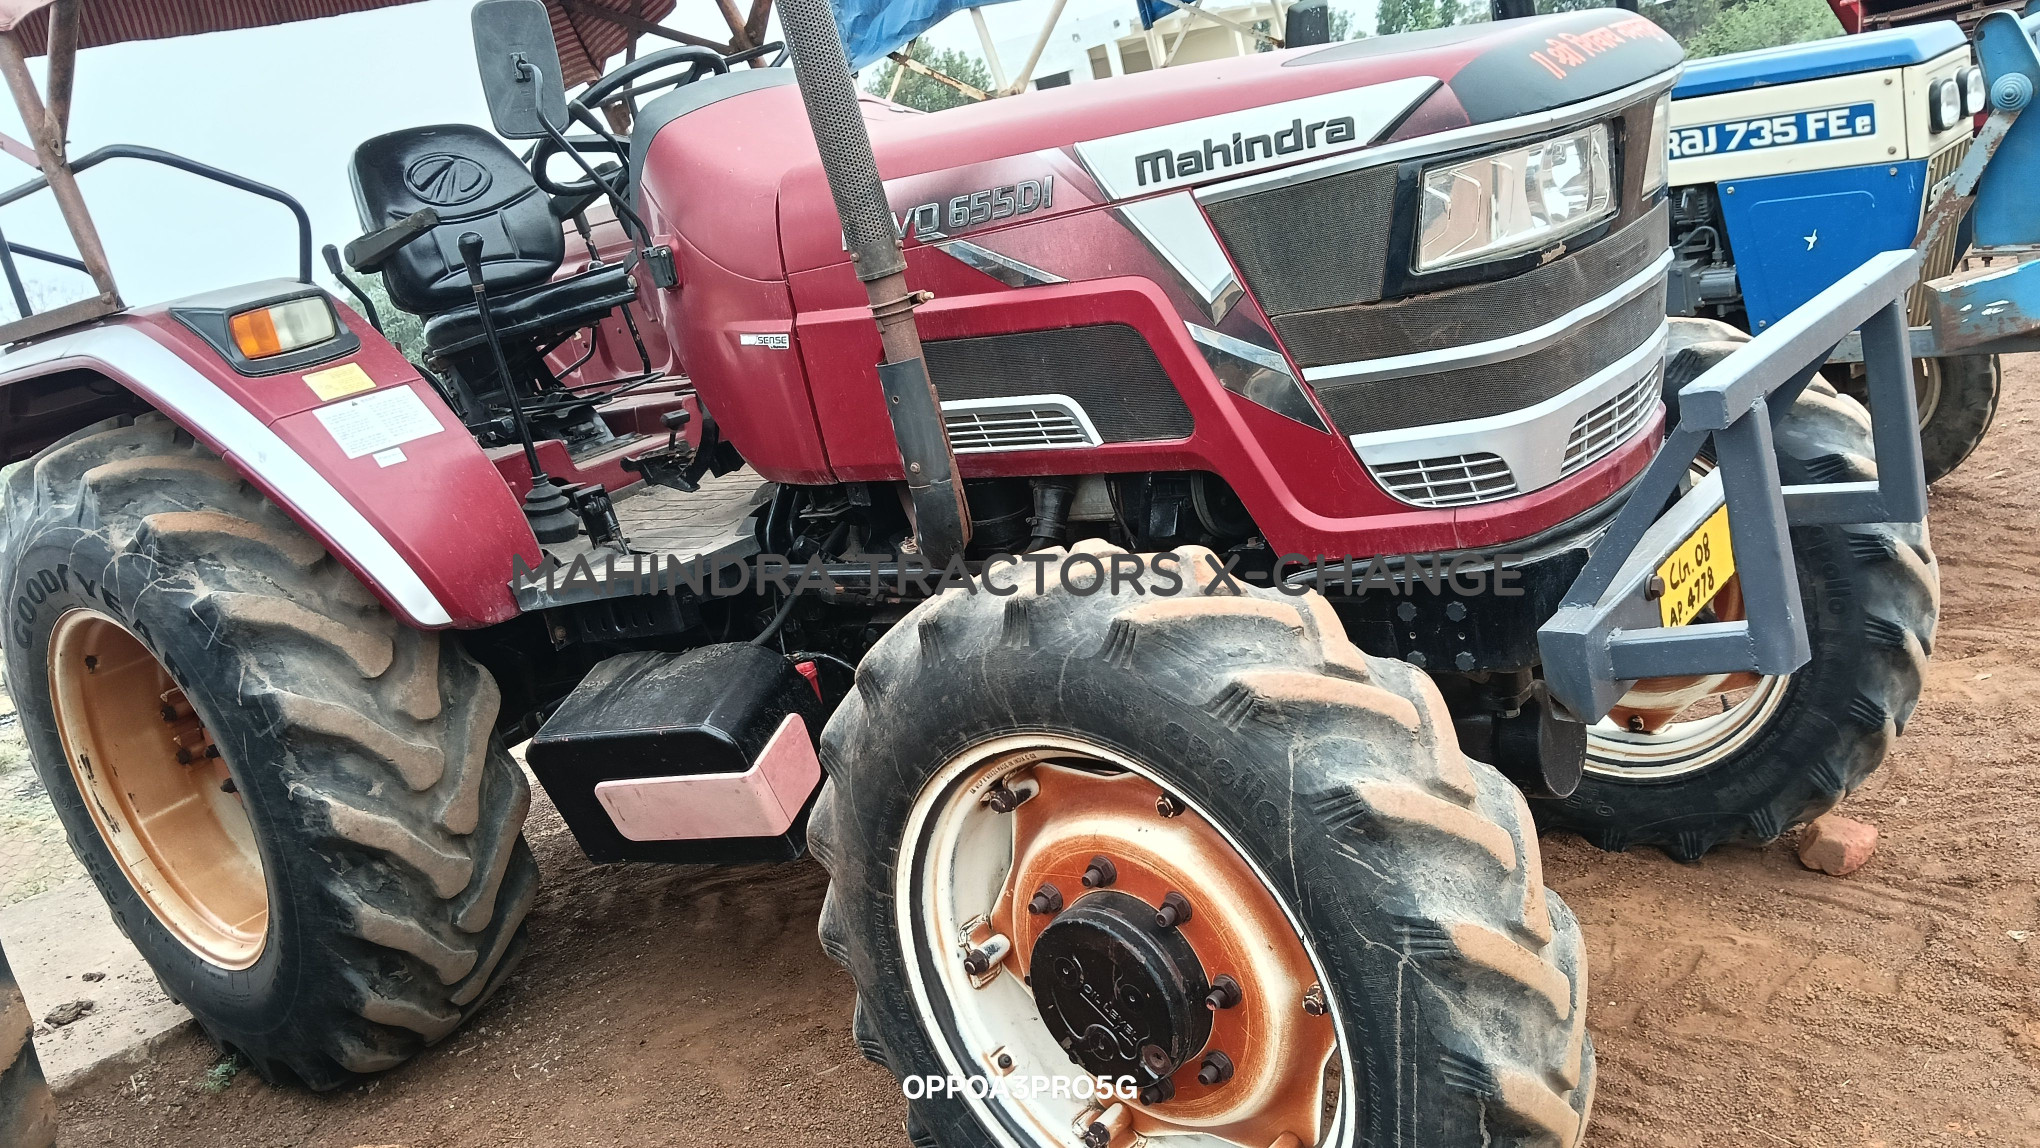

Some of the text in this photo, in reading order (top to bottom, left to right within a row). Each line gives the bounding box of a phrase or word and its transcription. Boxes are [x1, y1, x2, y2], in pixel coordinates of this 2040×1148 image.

[1134, 115, 1356, 187] Mahindra
[1725, 116, 1799, 151] 735
[1806, 108, 1853, 141] FE
[949, 175, 1054, 229] 655DI
